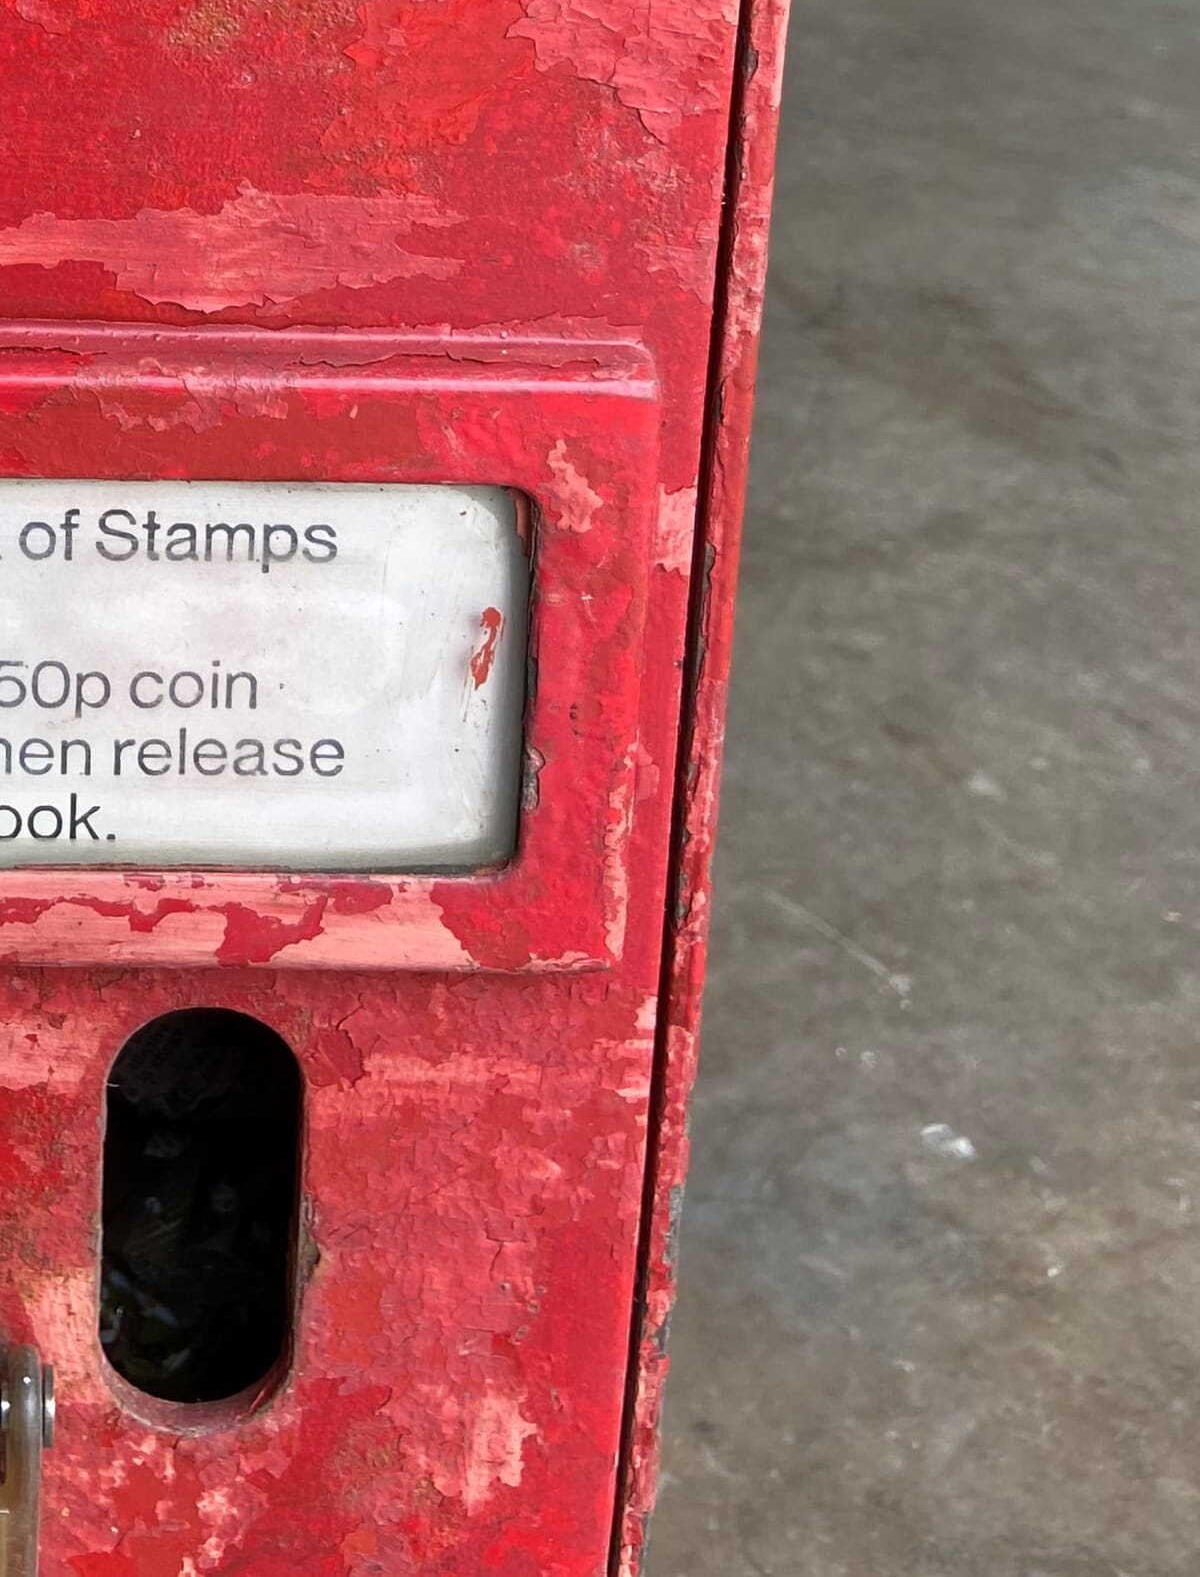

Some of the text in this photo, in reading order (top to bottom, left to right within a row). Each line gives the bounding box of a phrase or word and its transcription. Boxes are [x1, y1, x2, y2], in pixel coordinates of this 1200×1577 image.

[18, 508, 81, 562] of
[95, 508, 338, 575] Stamps
[128, 659, 258, 710] coin
[113, 726, 345, 778] release
